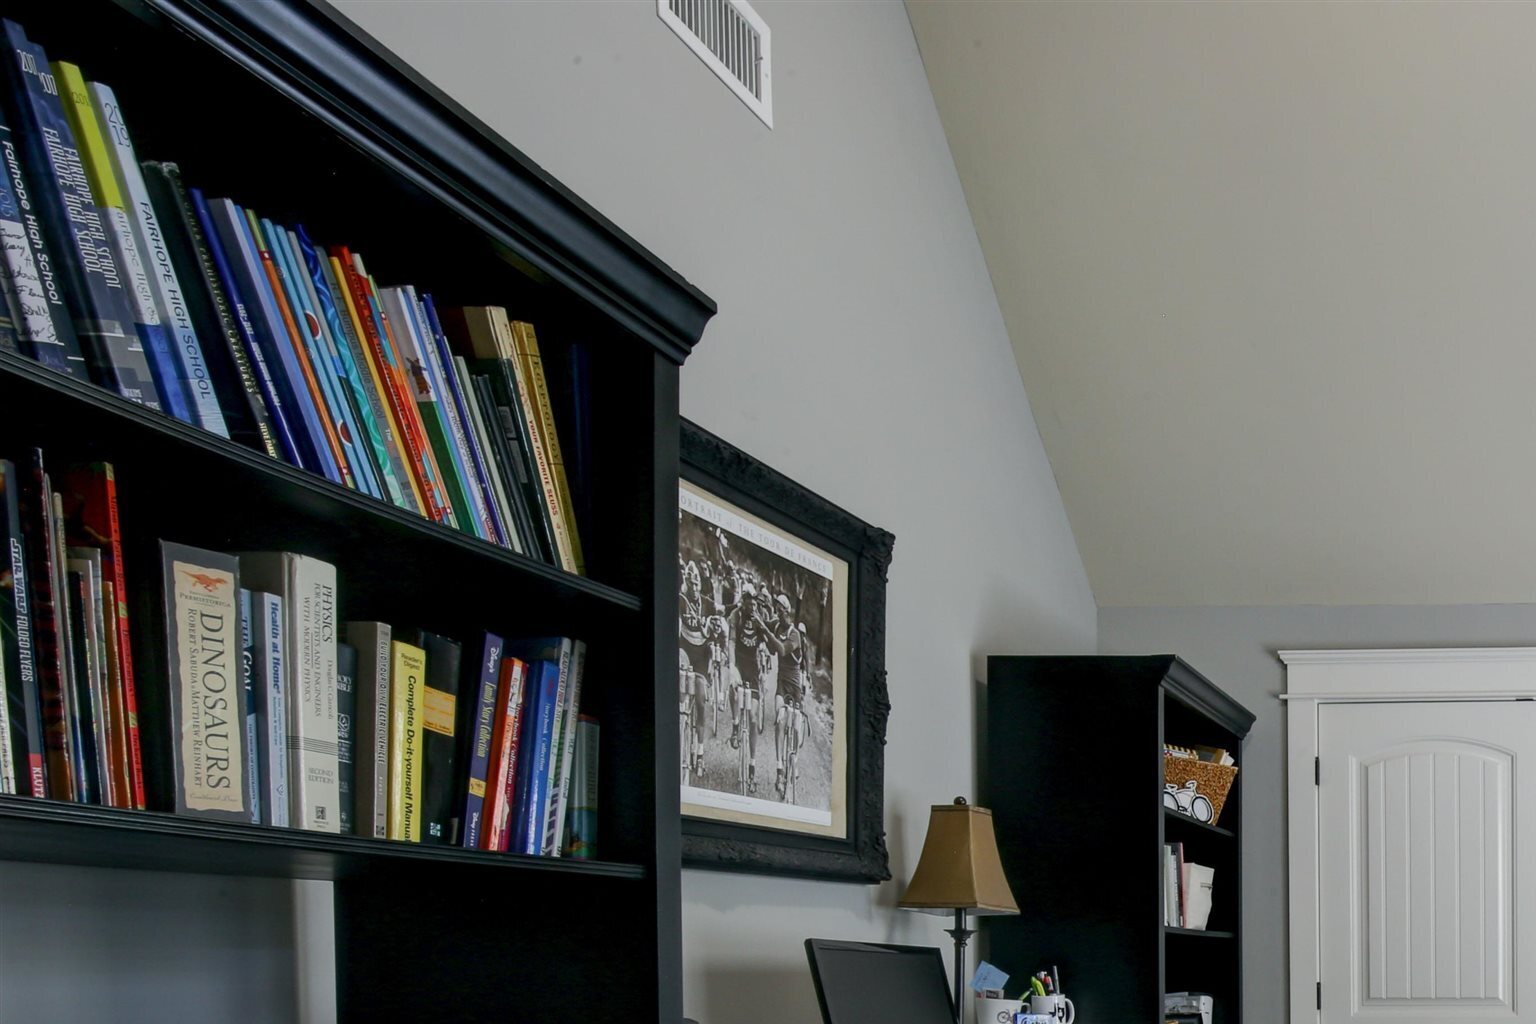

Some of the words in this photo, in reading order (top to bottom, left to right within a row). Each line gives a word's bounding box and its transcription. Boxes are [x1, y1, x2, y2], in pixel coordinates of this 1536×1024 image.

[104, 102, 124, 125] 20
[112, 126, 131, 148] 19
[43, 127, 71, 187] FAIRHOPE
[63, 191, 87, 226] HIGH
[75, 228, 101, 273] SCHOOL
[64, 147, 95, 206] FAIRHOPE
[84, 211, 107, 242] HIGH
[97, 246, 122, 289] SCHOOL
[3, 140, 30, 211] Fairhope
[25, 214, 44, 250] High
[37, 253, 62, 305] School
[113, 205, 139, 270] Fairhope
[136, 272, 153, 302] High
[141, 202, 175, 284] FAIRHOPE
[168, 288, 190, 332] HIGH
[182, 335, 212, 402] SCHOOL
[530, 359, 562, 460] EGYPTOLOGY
[526, 417, 540, 444] YOUR
[533, 444, 551, 486] FAVORITE
[544, 487, 560, 516] SEUSS
[680, 495, 721, 523] ORTRAIT
[759, 535, 781, 551] TOUR
[798, 552, 827, 573] FRANCE
[10, 537, 23, 577] STAR
[14, 578, 28, 614] WARS
[321, 584, 334, 643] PHYSICS
[17, 614, 31, 651] FOLDED
[186, 607, 198, 645] ROBERT
[269, 601, 280, 641] Health
[188, 647, 200, 683] SABUDA
[302, 625, 311, 665] MODERN
[379, 640, 388, 661] BUILD
[20, 652, 34, 682] FLYERS
[379, 663, 388, 683] YOUR
[199, 611, 231, 790] DINOSAURS
[313, 671, 321, 716] ENGINEERS
[405, 675, 418, 726] Complete
[482, 680, 497, 704] Family
[190, 689, 202, 737] MATTHEW
[378, 702, 387, 734] ELECTRIC
[479, 703, 494, 724] Story
[377, 735, 386, 764] VEHICLE
[475, 723, 492, 758] Collection
[31, 766, 45, 798] KLUTZ
[192, 738, 204, 787] REINHART
[402, 728, 416, 801] Do-it-yourself
